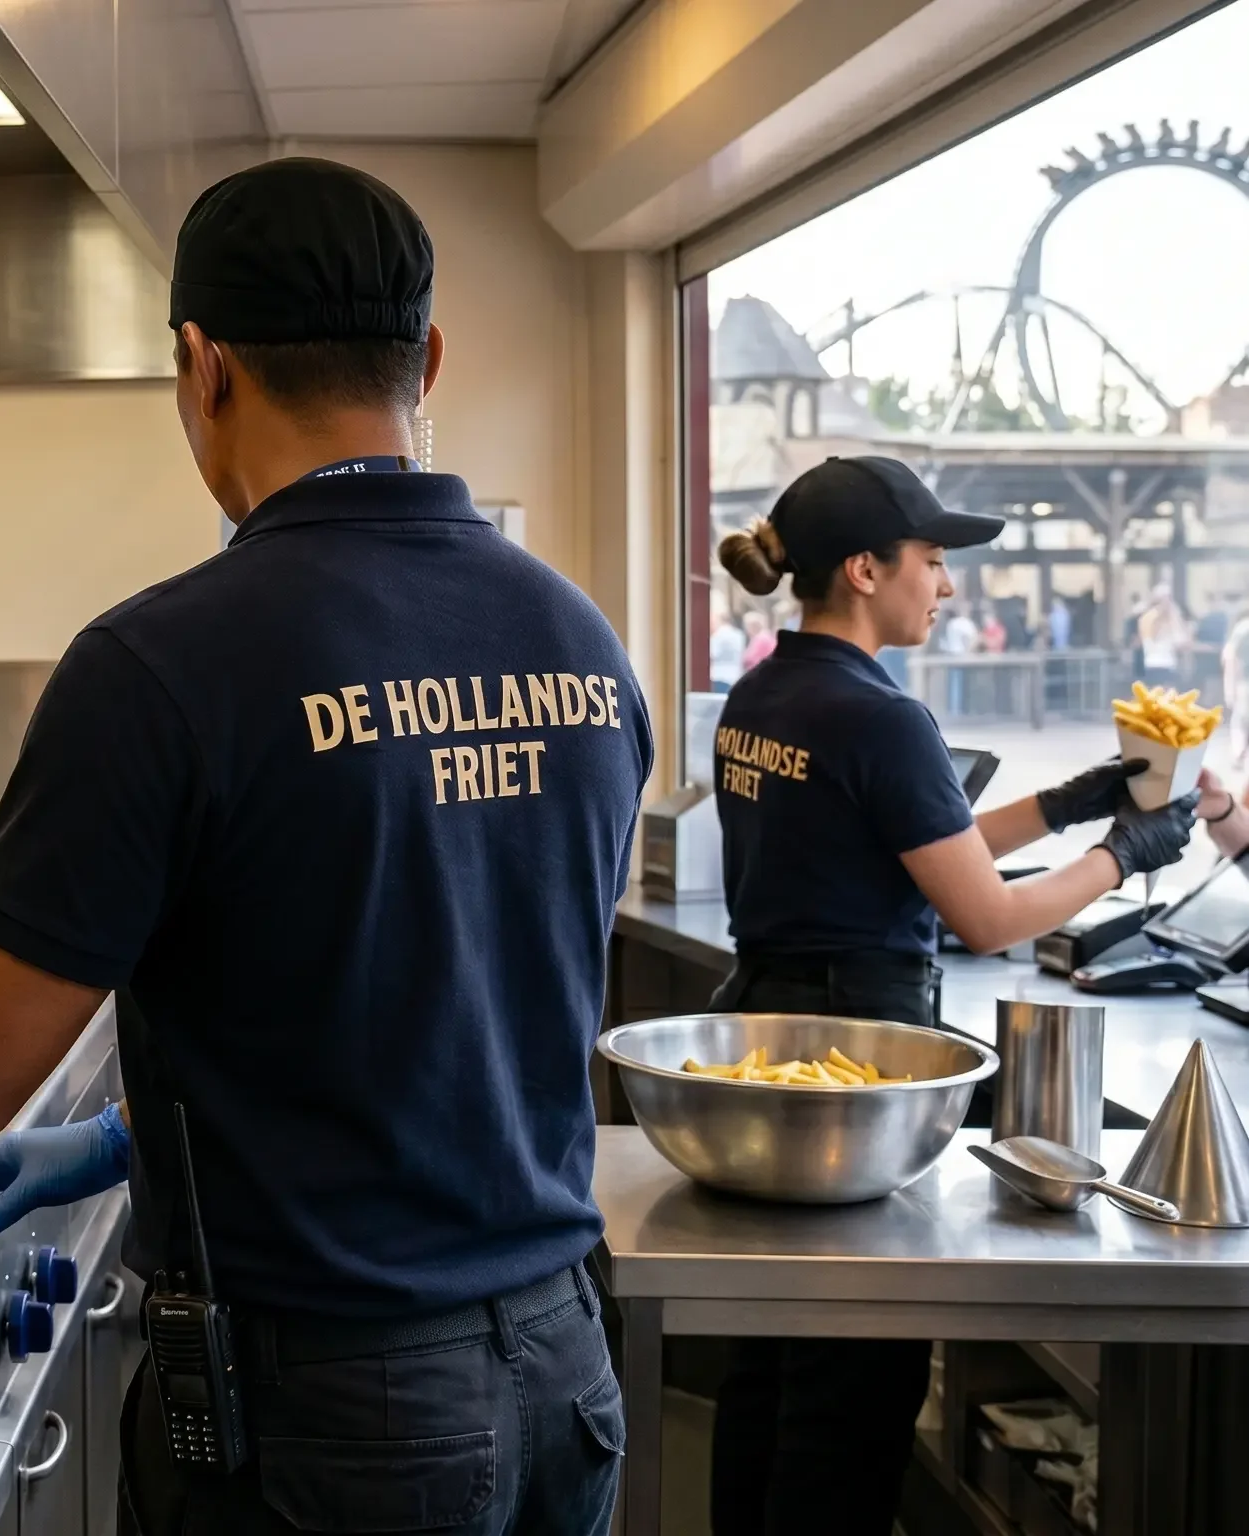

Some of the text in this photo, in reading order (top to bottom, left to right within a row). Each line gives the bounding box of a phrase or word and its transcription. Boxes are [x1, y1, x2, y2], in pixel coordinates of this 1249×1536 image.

[301, 673, 621, 753] DE HOLLANDSE
[430, 741, 547, 805] FRIET
[717, 726, 810, 781] HOLLANDSE
[723, 761, 762, 801] FRIET
